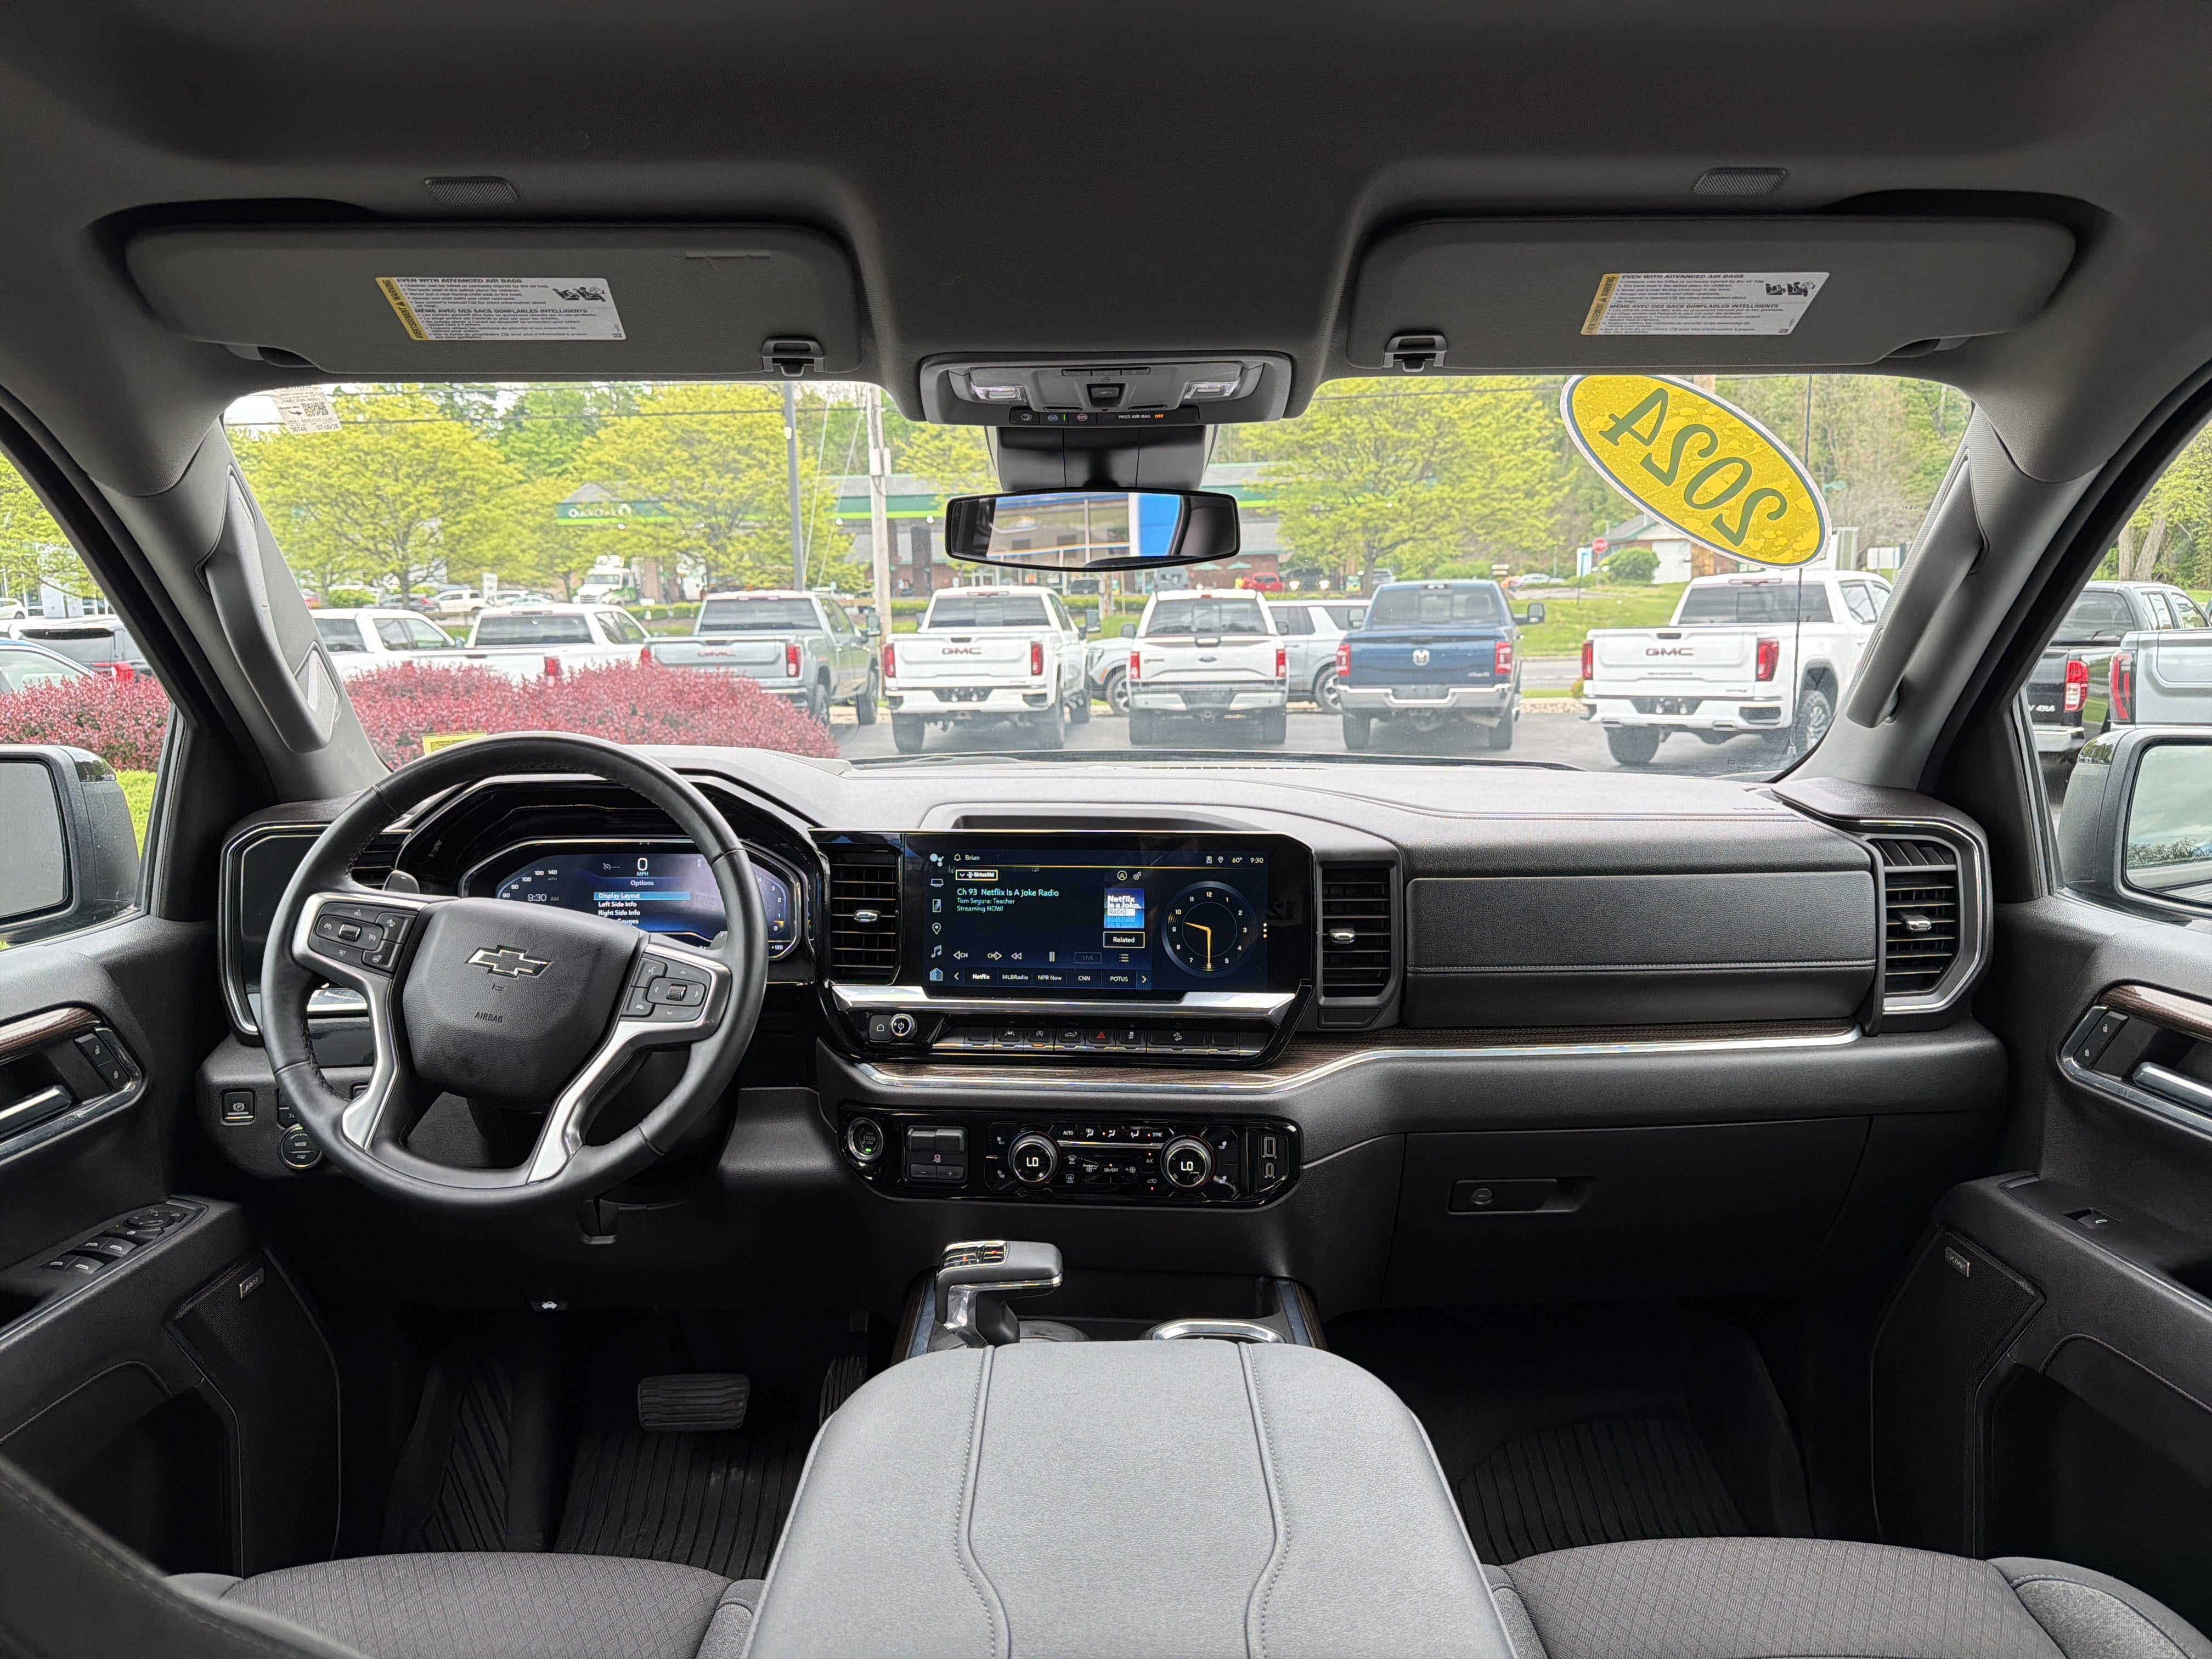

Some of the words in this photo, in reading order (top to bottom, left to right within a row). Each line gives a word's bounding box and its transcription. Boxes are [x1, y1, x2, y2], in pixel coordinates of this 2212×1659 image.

[1646, 648, 1694, 656] GMC
[637, 857, 648, 871] 0
[1020, 889, 1036, 898] Joke
[475, 1012, 503, 1024] AIRBAG
[1026, 1157, 1039, 1167] LO
[1181, 1161, 1193, 1171] LO
